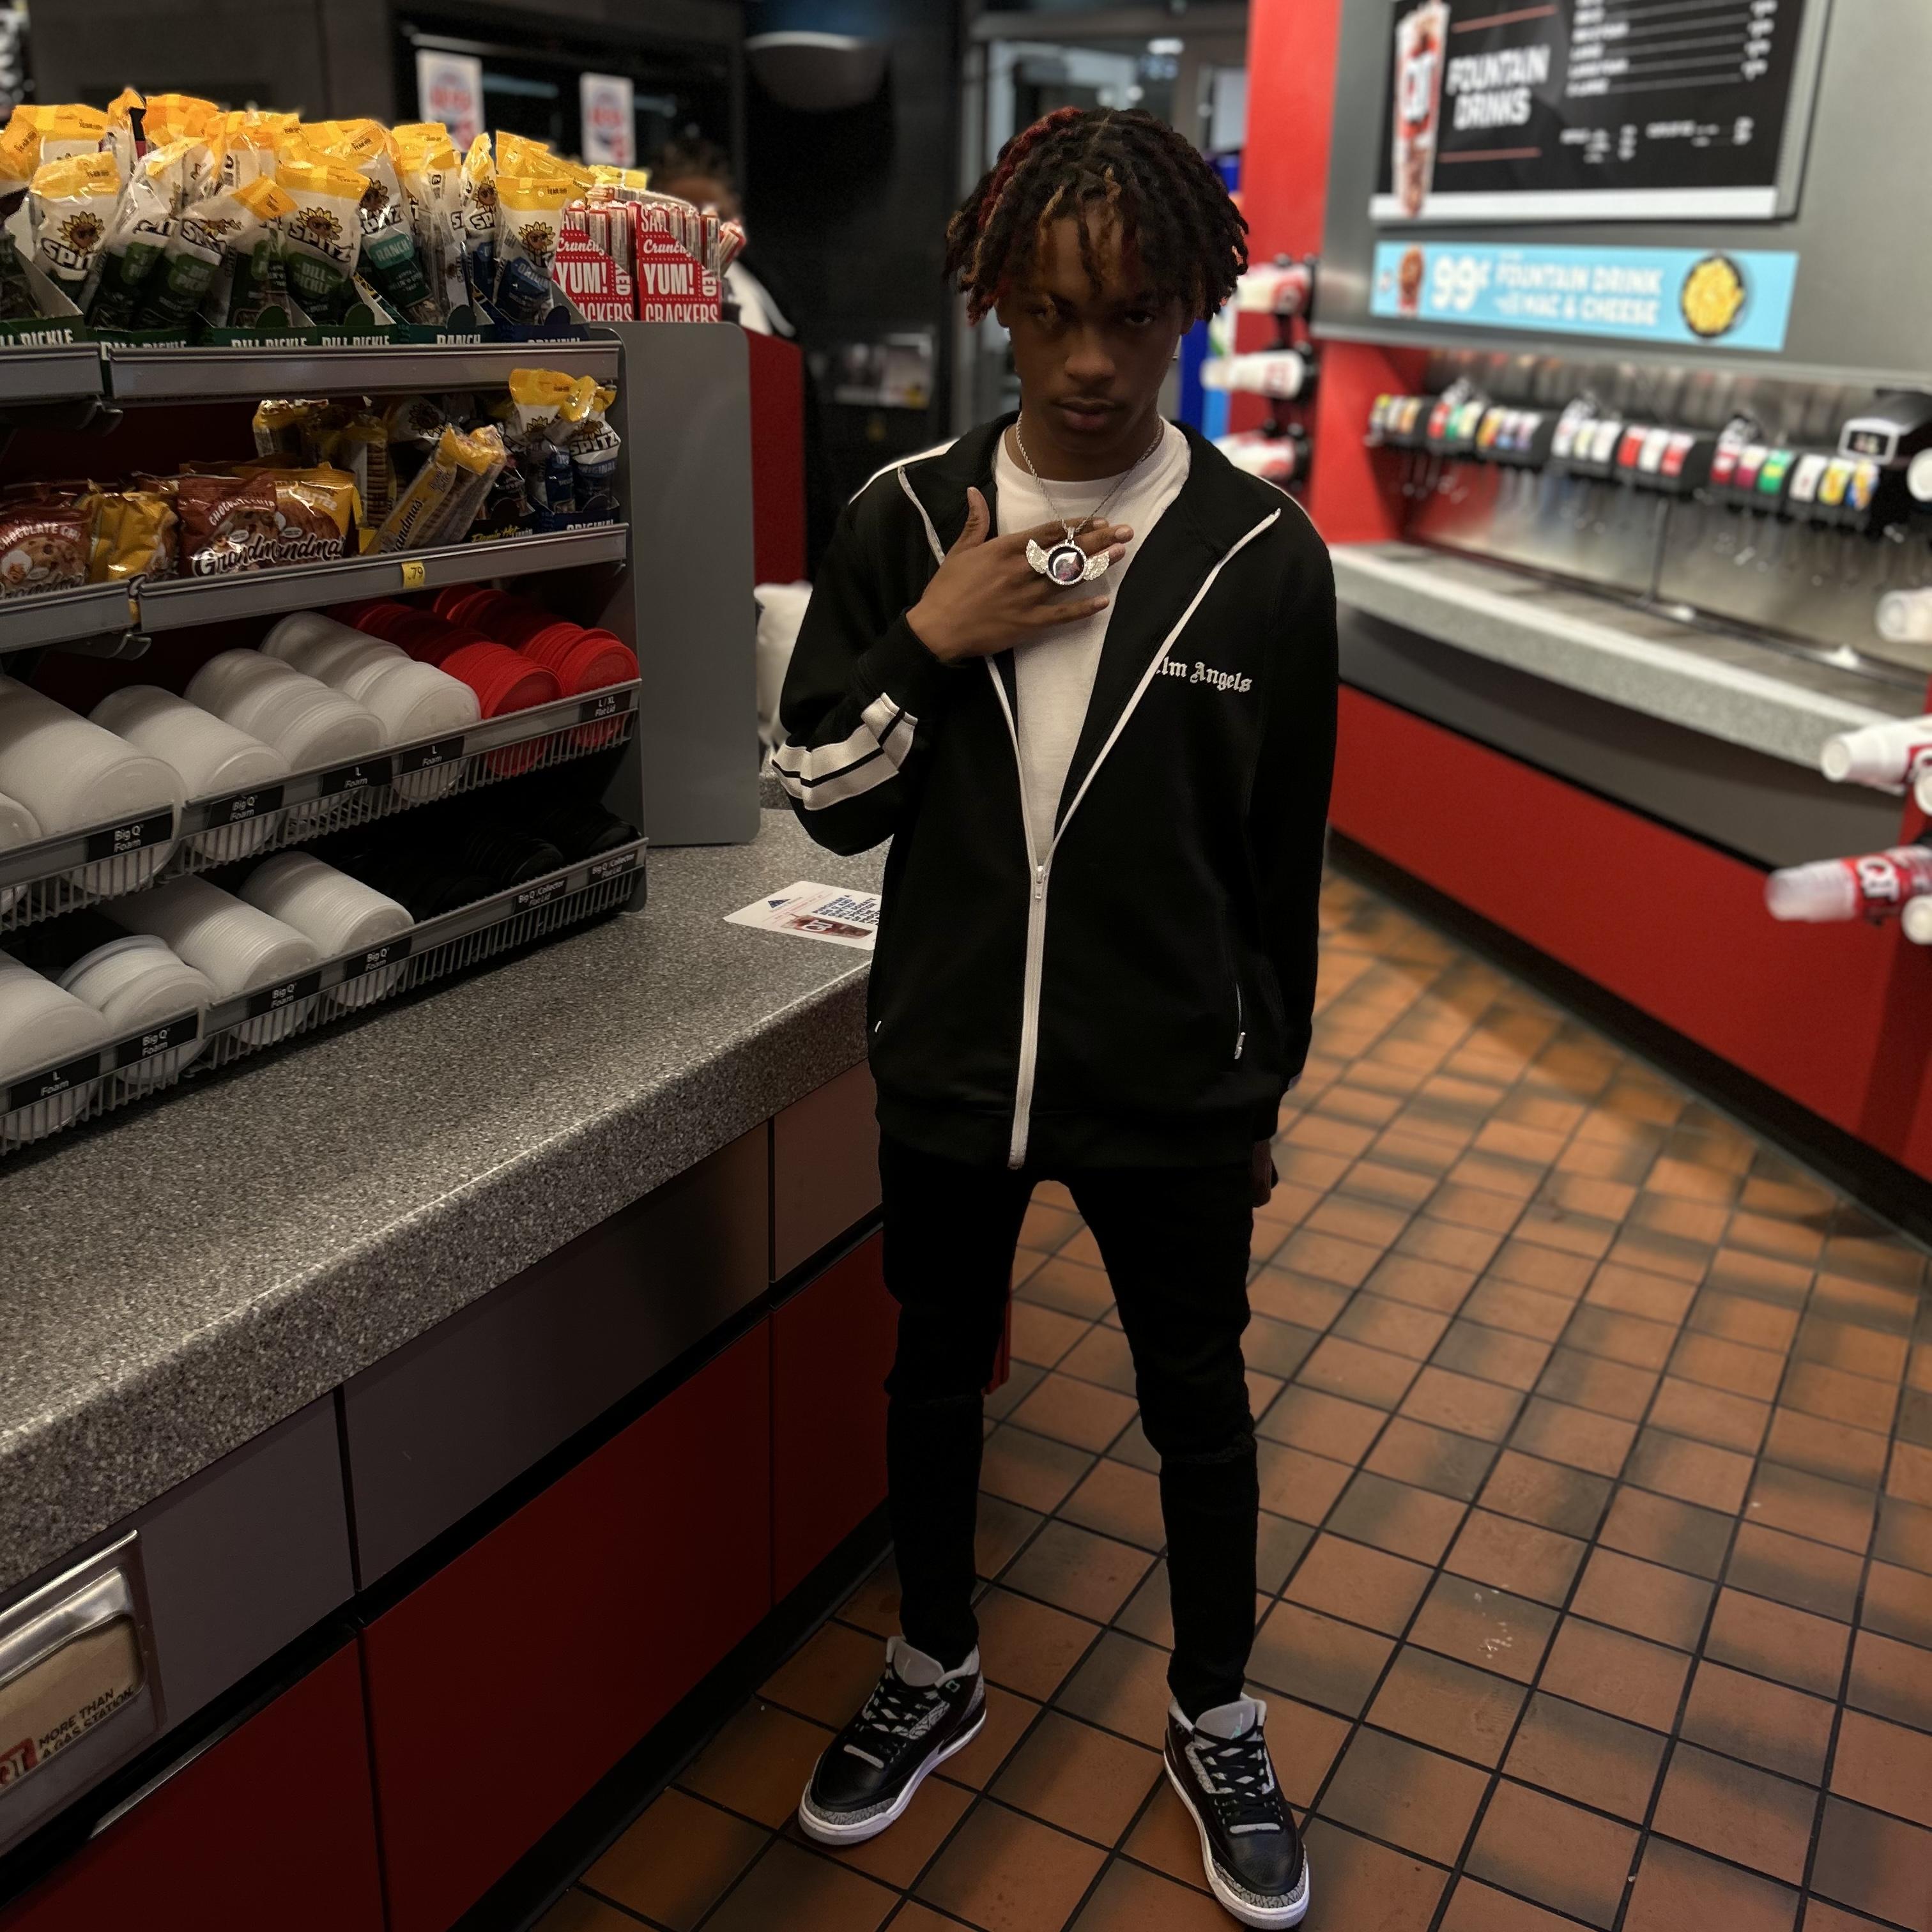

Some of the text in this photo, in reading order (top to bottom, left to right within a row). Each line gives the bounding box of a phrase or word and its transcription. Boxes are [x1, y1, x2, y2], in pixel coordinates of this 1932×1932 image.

[1446, 43, 1550, 95] FOUNTAIN
[1453, 86, 1531, 130] DRINKS
[556, 262, 608, 294] YUM!
[643, 263, 694, 295] YUM!
[645, 303, 718, 322] CRACKERS
[571, 432, 619, 455] SPITZ
[408, 566, 424, 580] .79
[1190, 661, 1252, 693] Angels
[422, 755, 442, 767] Foam
[355, 767, 361, 776] L
[344, 777, 368, 790] Foam
[230, 809, 254, 821] Foam
[114, 839, 141, 853] Foam
[53, 1071, 60, 1081] L
[41, 1080, 69, 1096] Foam
[39, 1688, 114, 1749] MORE THAN
[42, 1749, 50, 1758] A
